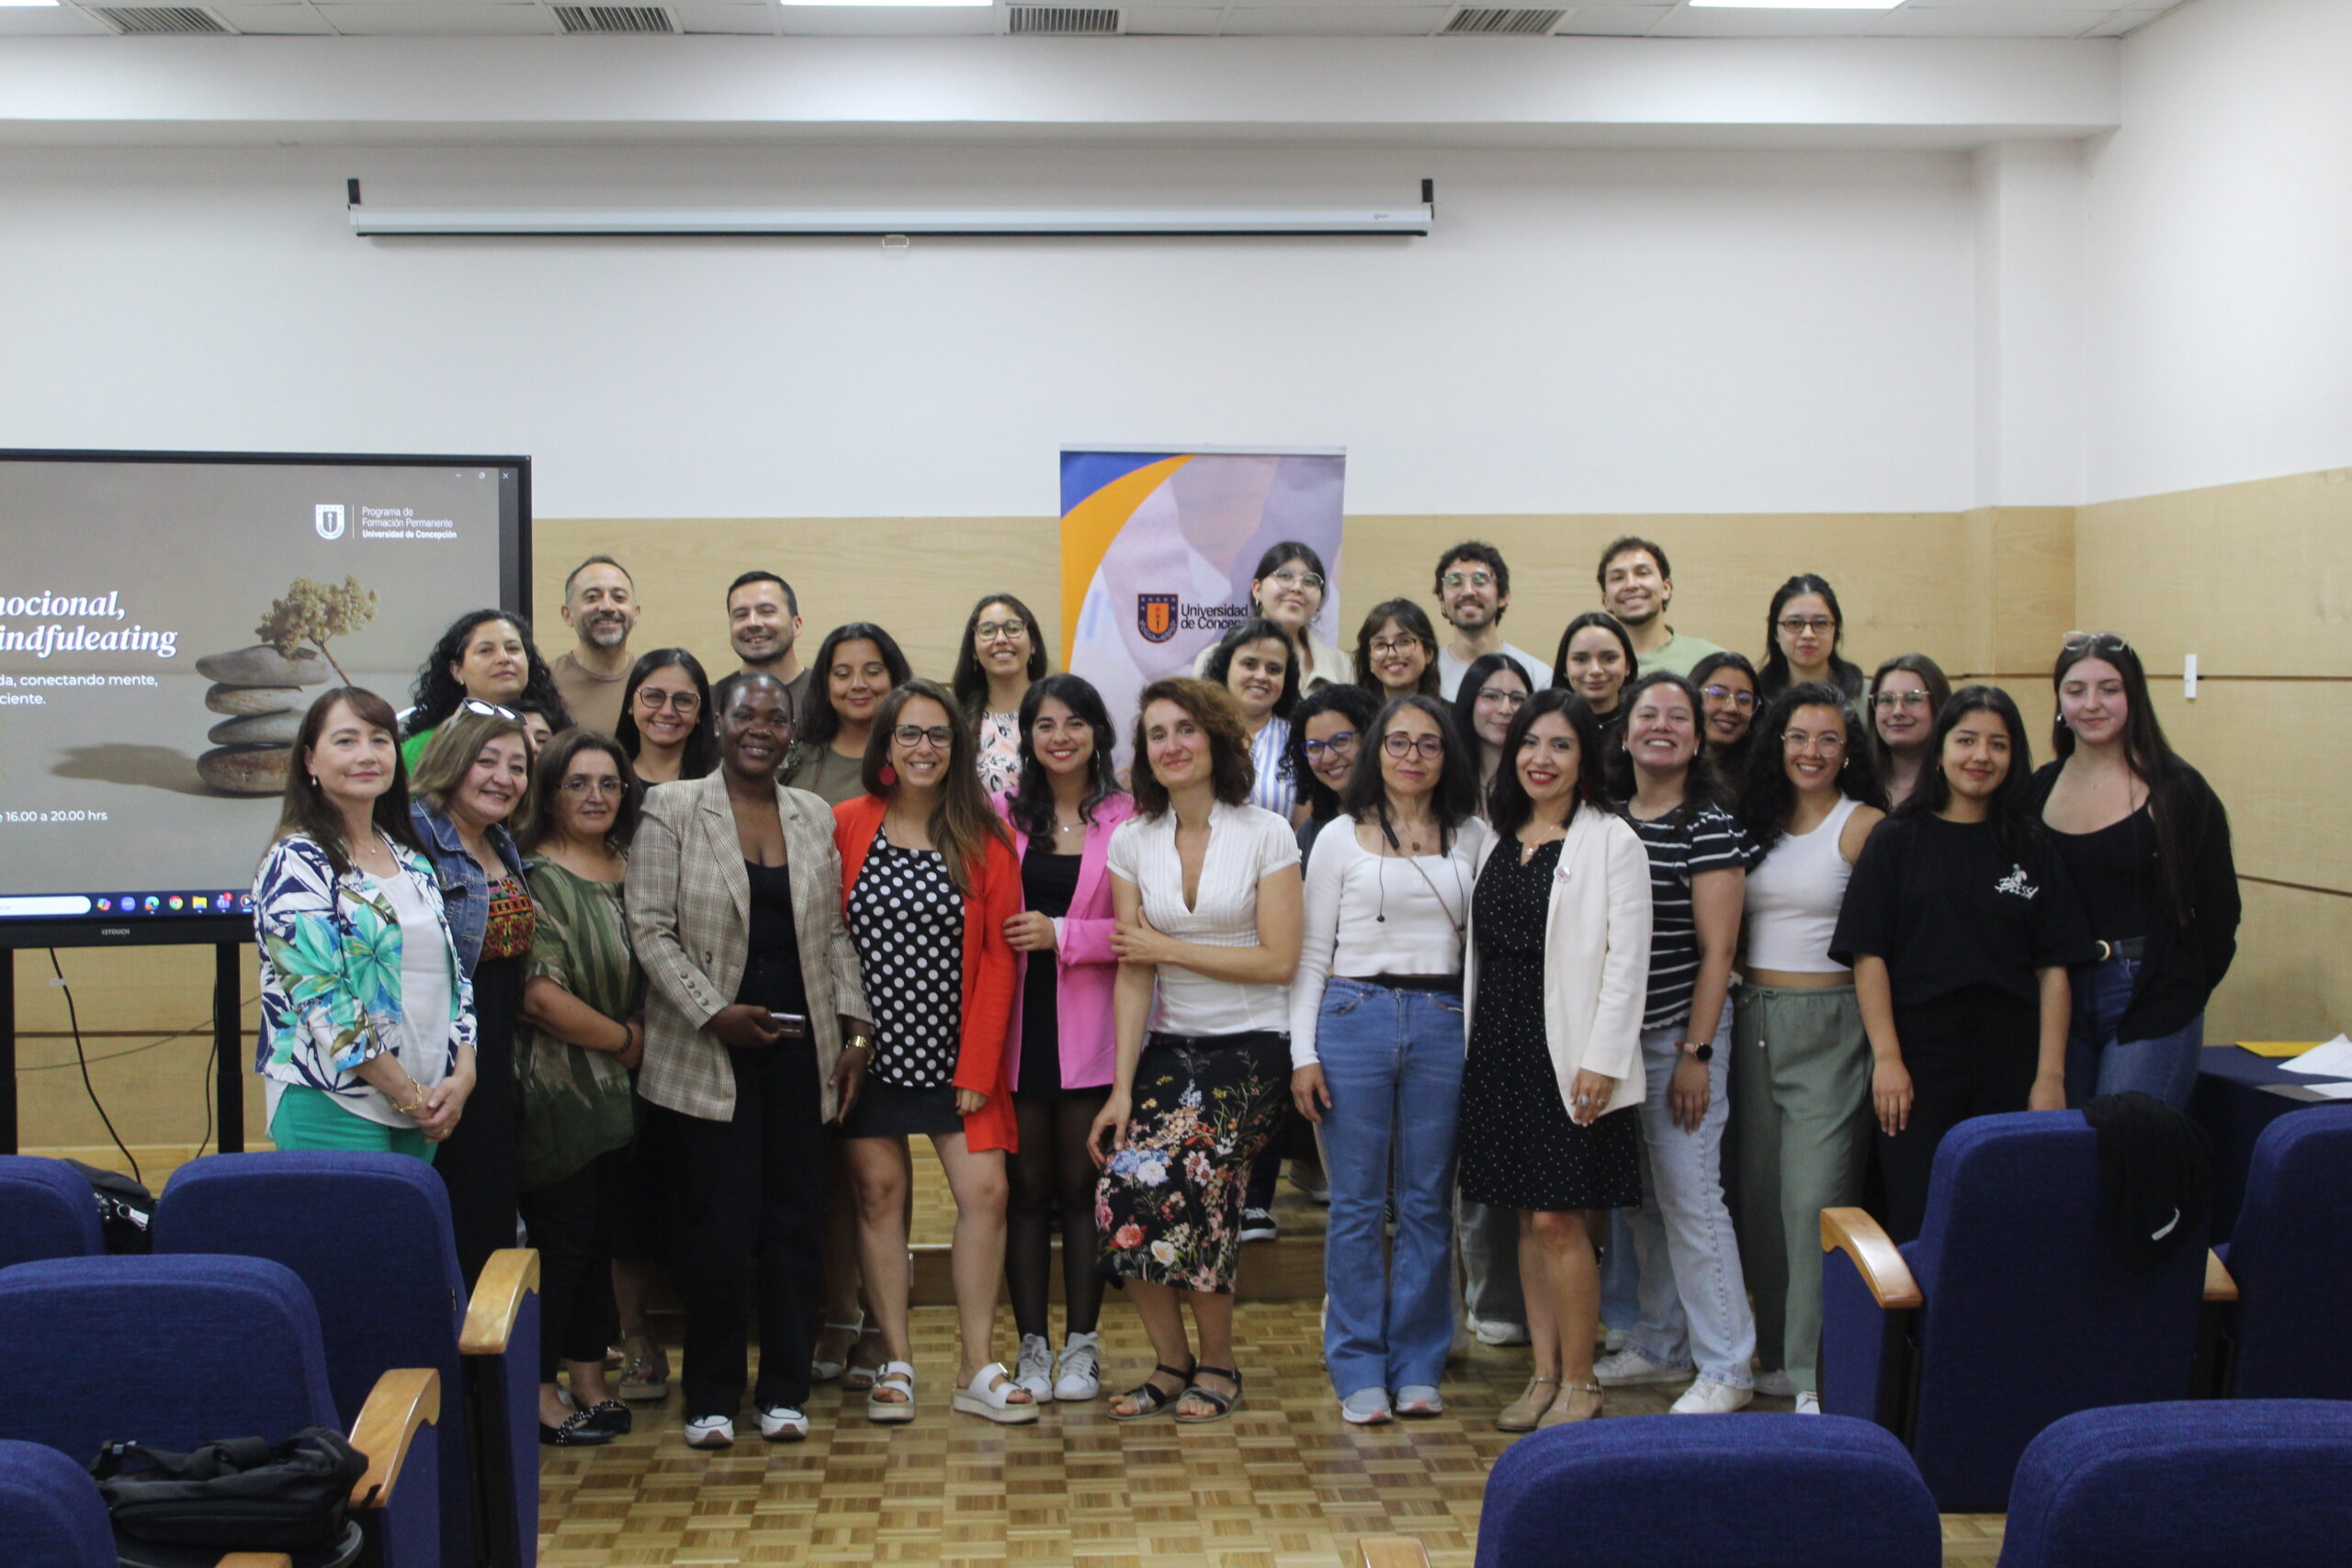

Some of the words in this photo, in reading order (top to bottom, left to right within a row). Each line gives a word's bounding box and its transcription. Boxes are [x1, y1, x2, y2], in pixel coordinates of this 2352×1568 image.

[362, 506, 401, 518] Programa
[402, 507, 413, 516] de
[362, 517, 403, 527] Formación
[405, 518, 453, 528] Permanente
[362, 530, 403, 538] Universidad
[416, 530, 458, 540] Concepción
[0, 590, 126, 621] ocional,
[1181, 604, 1249, 618] Universidad
[1181, 616, 1195, 629] de
[20, 674, 105, 686] conectando
[108, 675, 158, 687] mente,
[6, 811, 38, 822] 16.00
[40, 812, 48, 821] a
[51, 810, 85, 821] 20.00
[87, 810, 108, 821] hrs
